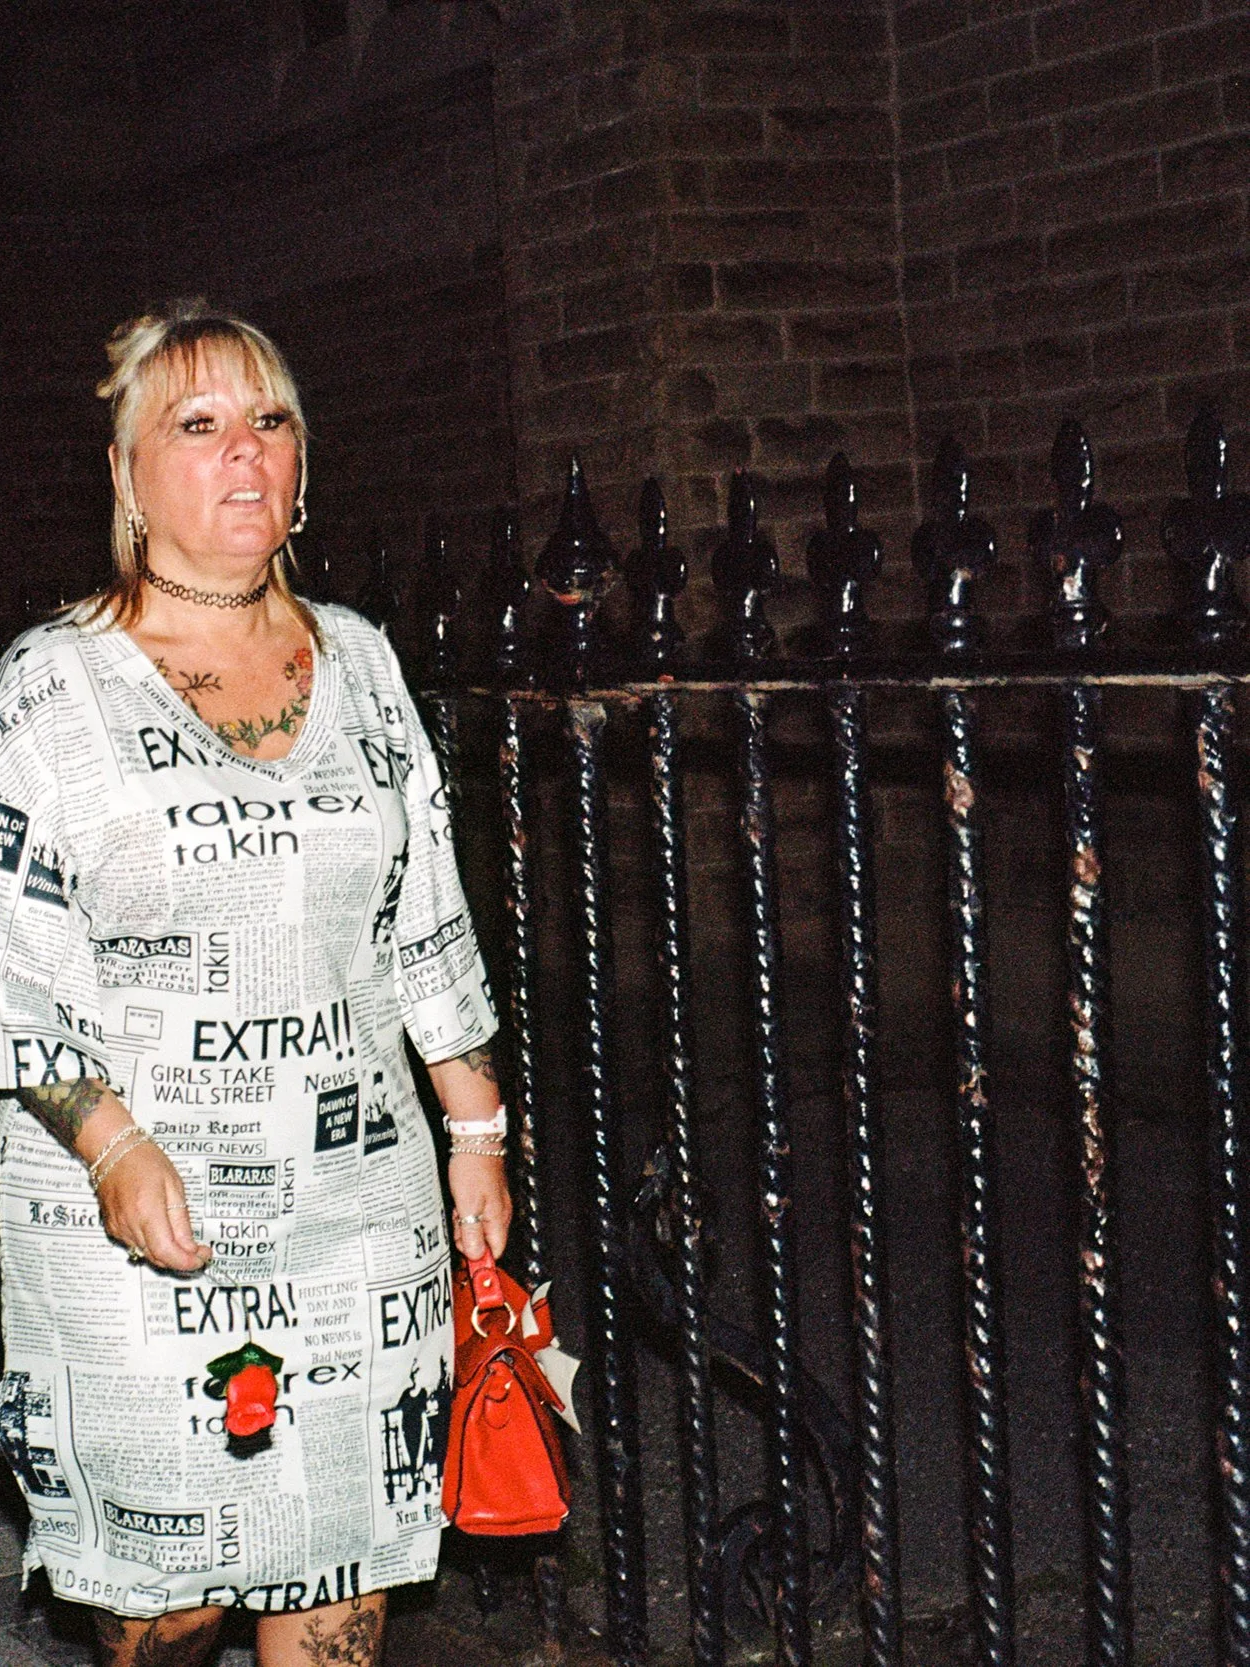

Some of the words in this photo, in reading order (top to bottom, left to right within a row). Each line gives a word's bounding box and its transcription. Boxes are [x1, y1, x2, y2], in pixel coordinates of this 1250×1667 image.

[10, 819, 26, 833] OF
[173, 825, 299, 867] takin
[203, 931, 229, 994] takin
[4, 966, 49, 996] Priceless
[151, 1064, 212, 1085] GIRLS
[219, 1066, 275, 1085] TAKE
[304, 1067, 356, 1093] News
[153, 1084, 204, 1105] WALL
[210, 1084, 276, 1105] STREET
[318, 1096, 347, 1115] DAWN
[346, 1092, 358, 1107] OF
[152, 1121, 200, 1136] Daily
[207, 1120, 262, 1137] Report
[325, 1116, 333, 1129] A
[333, 1109, 353, 1126] NEW
[330, 1126, 347, 1142] ERA
[219, 1143, 263, 1155] NEWS
[281, 1157, 295, 1216] takin
[220, 1221, 270, 1240] takin
[366, 1215, 408, 1235] Priceless
[298, 1281, 359, 1299] HUSTLING
[174, 1282, 298, 1335] EXTRA!
[306, 1300, 329, 1313] DAY
[332, 1297, 356, 1310] AND
[313, 1313, 350, 1328] NIGHT
[304, 1334, 320, 1347] NO
[321, 1331, 352, 1345] NEWS
[353, 1329, 362, 1341] is
[311, 1351, 331, 1365] Bad
[334, 1349, 363, 1361] News
[216, 1503, 240, 1569] takin
